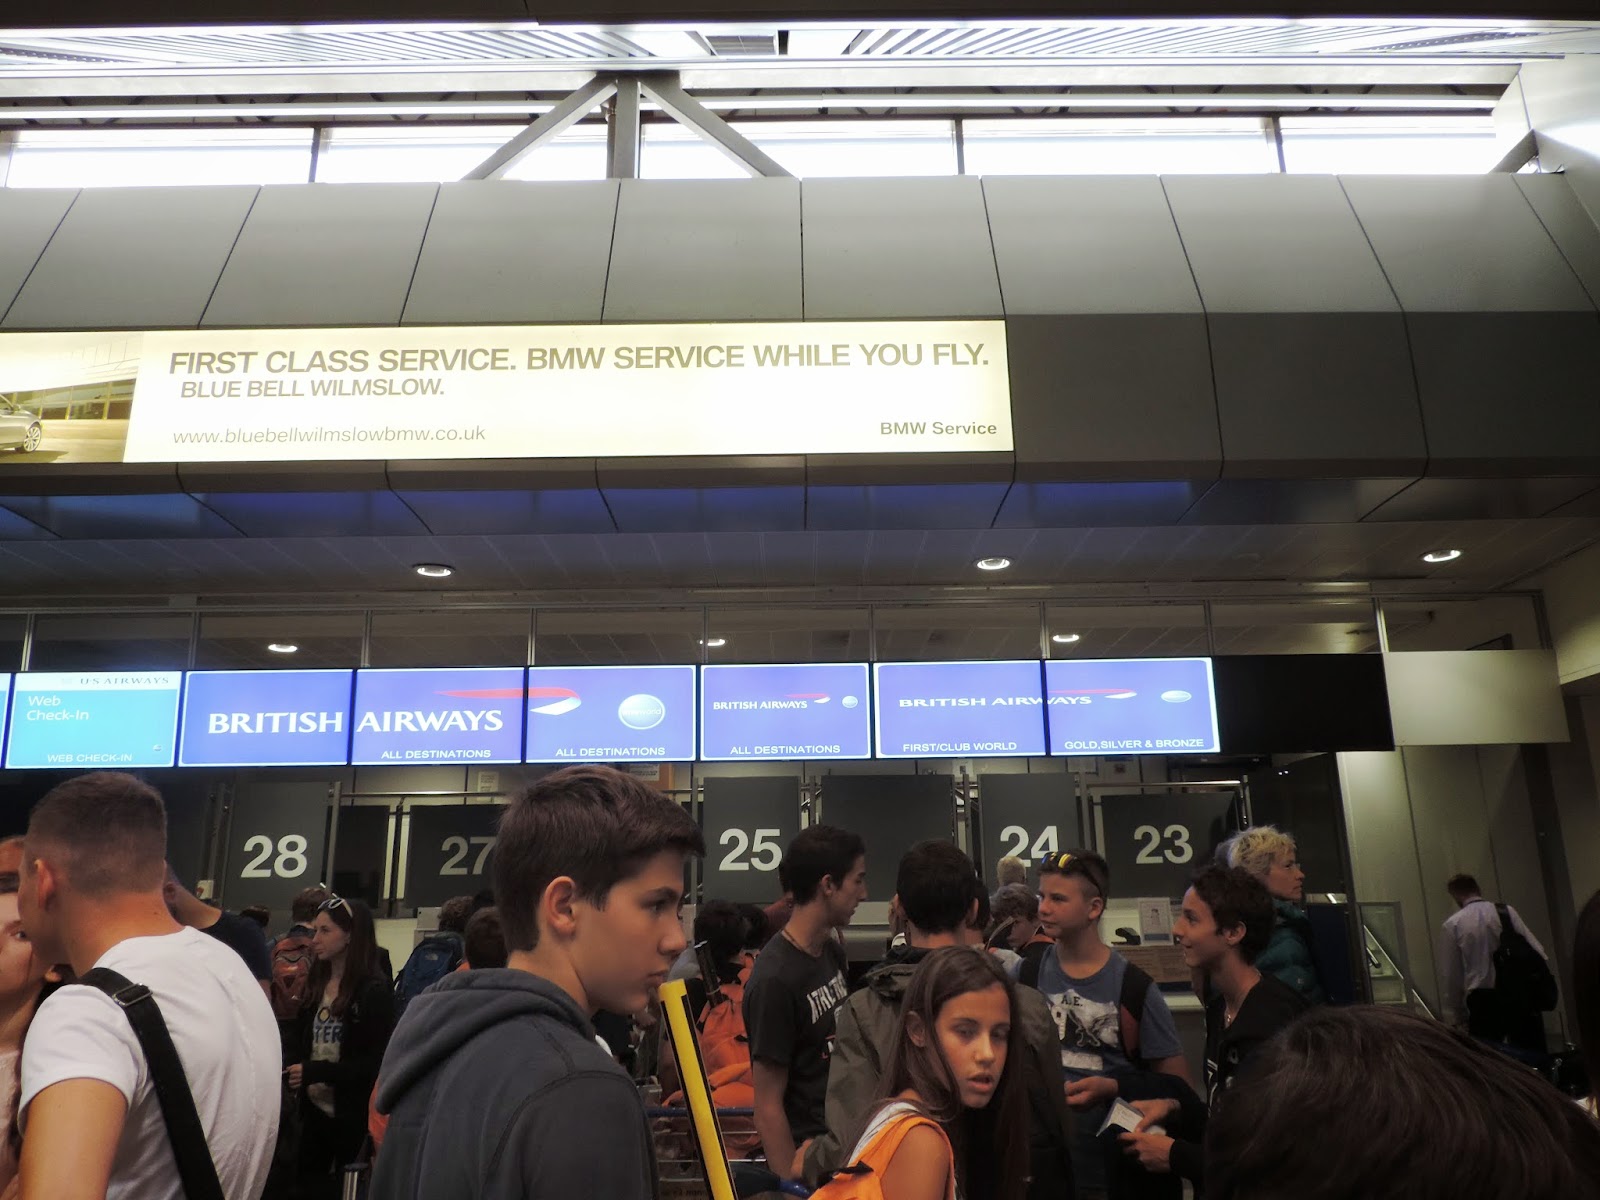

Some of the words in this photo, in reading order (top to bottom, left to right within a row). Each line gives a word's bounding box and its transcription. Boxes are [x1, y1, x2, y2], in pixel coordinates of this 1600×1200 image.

[169, 350, 258, 374] FIRST
[266, 349, 370, 373] CLASS
[378, 347, 517, 371] SERVICE.
[527, 347, 605, 370] BMW
[613, 345, 745, 369] SERVICE
[753, 343, 850, 367] WHILE
[859, 343, 923, 366] YOU
[933, 343, 989, 366] FLY.
[180, 381, 242, 398] BLUE
[247, 380, 305, 397] BELL
[311, 378, 445, 396] WILMSLOW.
[880, 422, 927, 435] BMW
[932, 421, 998, 435] Service
[173, 425, 486, 444] www.bluebellwilmslowbmw.co.uk
[104, 676, 169, 685] AIRWAYS
[28, 695, 61, 706] Web
[713, 701, 757, 710] BRITISH
[759, 700, 808, 709] AIRWAYS
[899, 697, 986, 707] BRITISH
[991, 696, 1092, 706] AIRWAYS
[26, 709, 89, 721] Check-In
[208, 711, 343, 734] BRITISH
[356, 709, 504, 732] AIRWAYS
[902, 742, 971, 752] FIRST/CLUB
[973, 741, 1017, 751] WORLD
[1145, 739, 1153, 748] &
[1155, 738, 1204, 748] BRONZE
[381, 750, 402, 759] ALL
[405, 749, 491, 759] DESTINATIONS
[555, 748, 577, 757] ALL
[579, 747, 666, 756] DESTINATIONS
[730, 746, 752, 755] ALL
[754, 744, 841, 754] DESTINATIONS
[47, 754, 74, 762] WEB
[76, 753, 132, 762] CHECK-IN
[718, 828, 783, 871] 25
[1000, 825, 1059, 868] 24
[1133, 824, 1193, 864] 23
[240, 834, 308, 878] 28
[439, 836, 497, 875] 27
